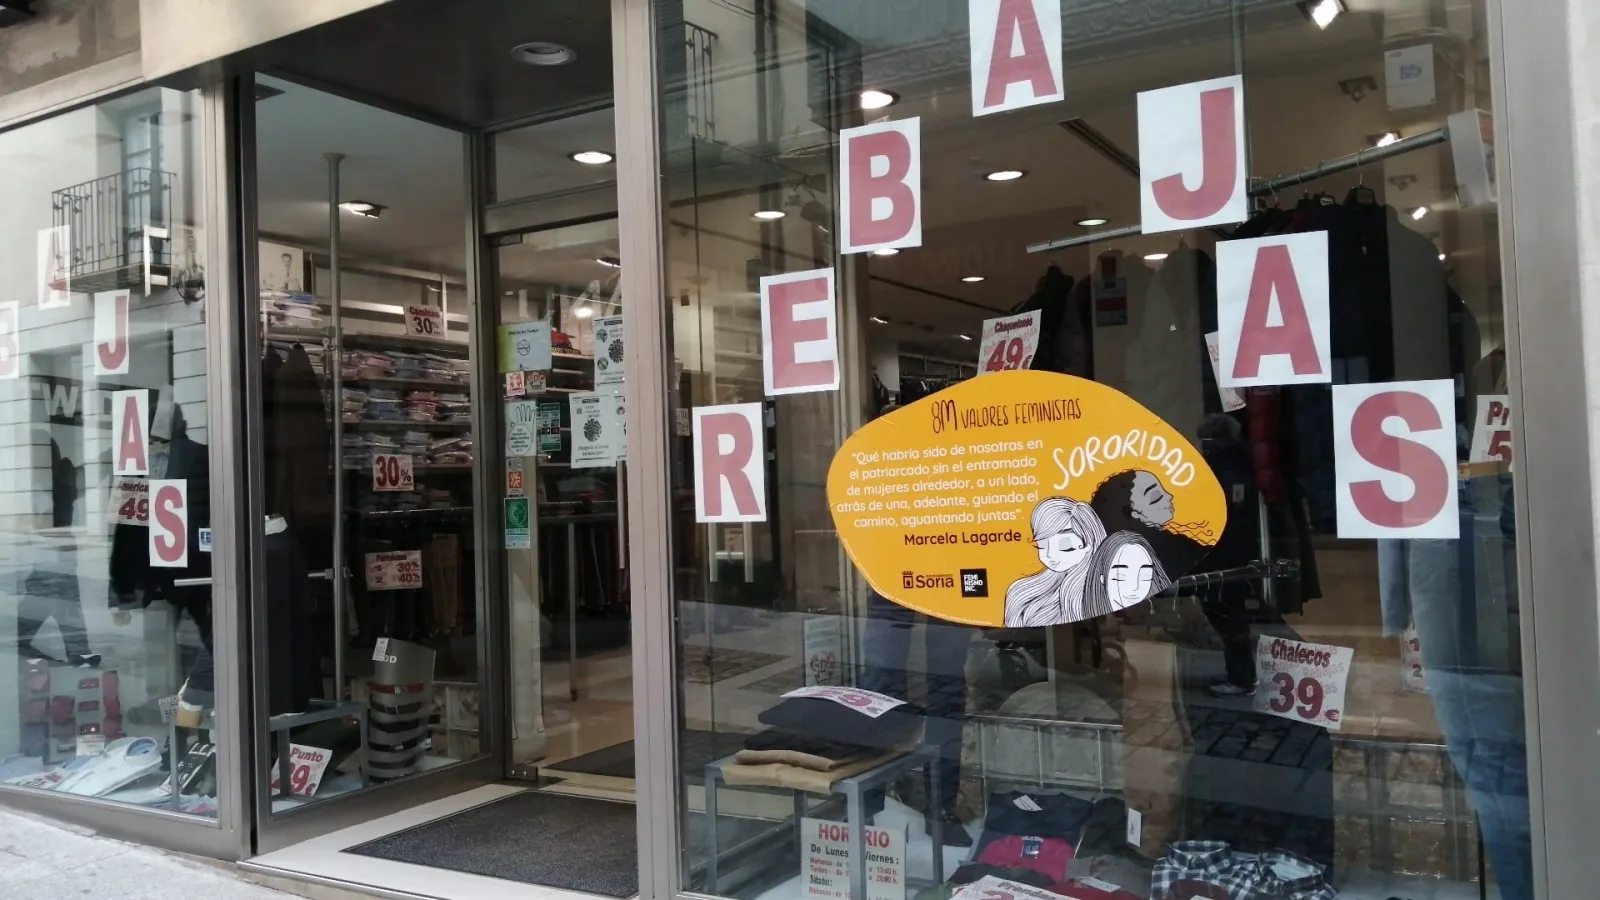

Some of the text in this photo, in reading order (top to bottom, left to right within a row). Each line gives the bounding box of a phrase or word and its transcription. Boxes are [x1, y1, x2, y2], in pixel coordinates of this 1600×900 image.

[931, 398, 1082, 434] 8M VALORES FEMINISTAS
[882, 447, 920, 462] habría
[923, 446, 947, 459] sido
[950, 444, 965, 456] de
[969, 440, 1024, 454] nosotras
[1027, 439, 1043, 450] en
[1052, 429, 1195, 490] SORORIDAD
[849, 456, 1037, 481] el patriarcado sin el entramado
[847, 485, 860, 497] de
[863, 482, 909, 497] mujeres
[976, 479, 985, 488] a
[988, 477, 1004, 487] un
[1008, 473, 1040, 487] lado,
[837, 490, 1039, 513] atrás de una, adelante, guiando el
[854, 514, 898, 528] camino,
[901, 512, 974, 528] aguantando
[904, 529, 1022, 546] Marcela Lagarde
[916, 574, 954, 588] Soria
[1271, 638, 1331, 668] Chalecos
[291, 747, 323, 762] Punto
[811, 843, 821, 854] De
[825, 845, 849, 858] Lunes
